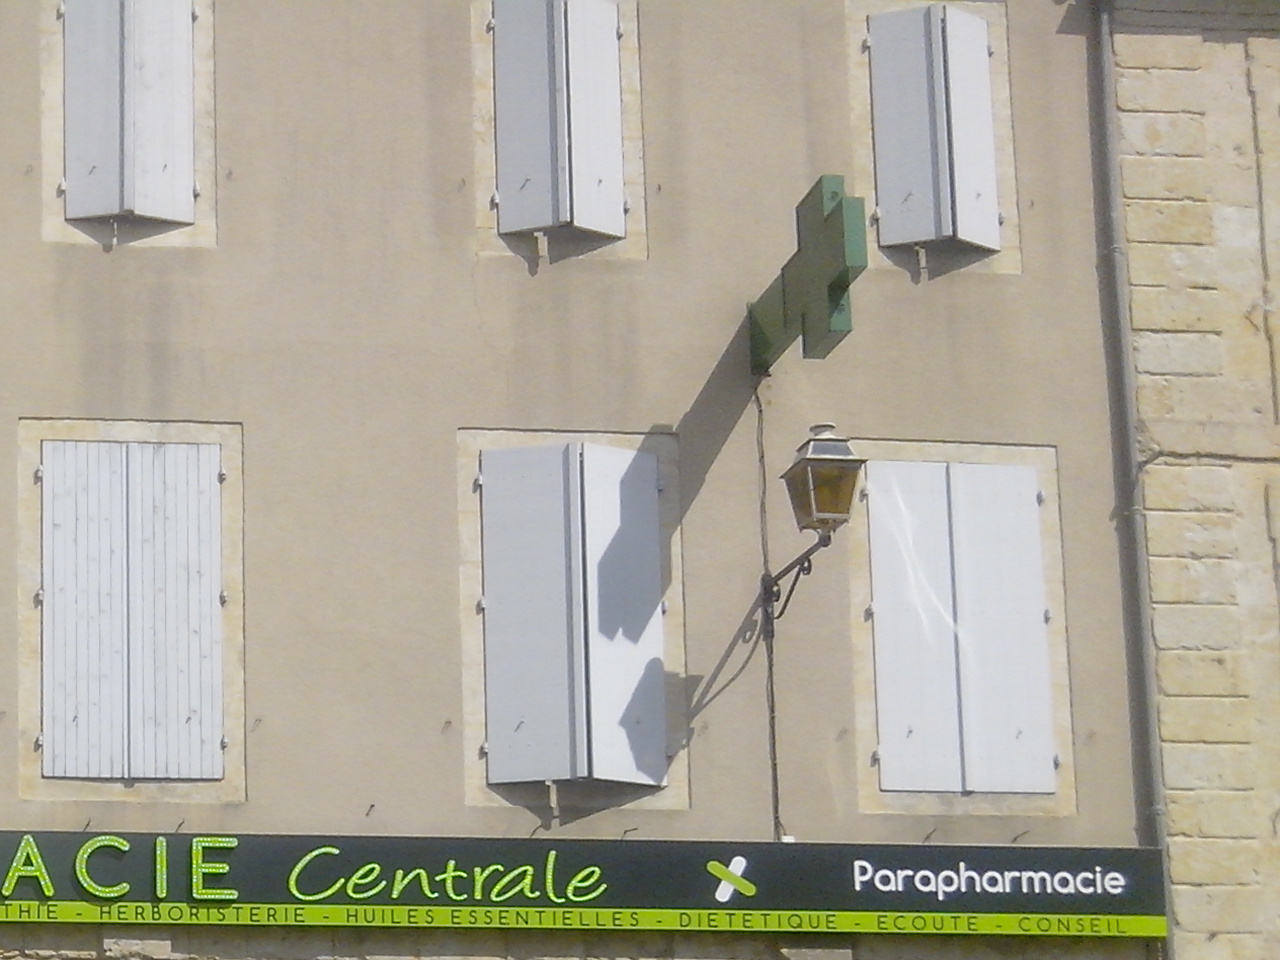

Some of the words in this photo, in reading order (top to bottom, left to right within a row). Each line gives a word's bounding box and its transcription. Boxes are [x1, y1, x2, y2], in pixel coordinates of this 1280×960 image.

[287, 845, 608, 904] Centrale
[852, 858, 1127, 901] Parapharmacie
[99, 904, 306, 924] HERBORISTERIE
[346, 907, 435, 925] HUILES
[450, 909, 640, 927] ESSENTIELLES
[679, 912, 838, 931] DIETETIQUE
[877, 914, 979, 932] ECOUTE
[1019, 916, 1128, 935] CONSEIL
